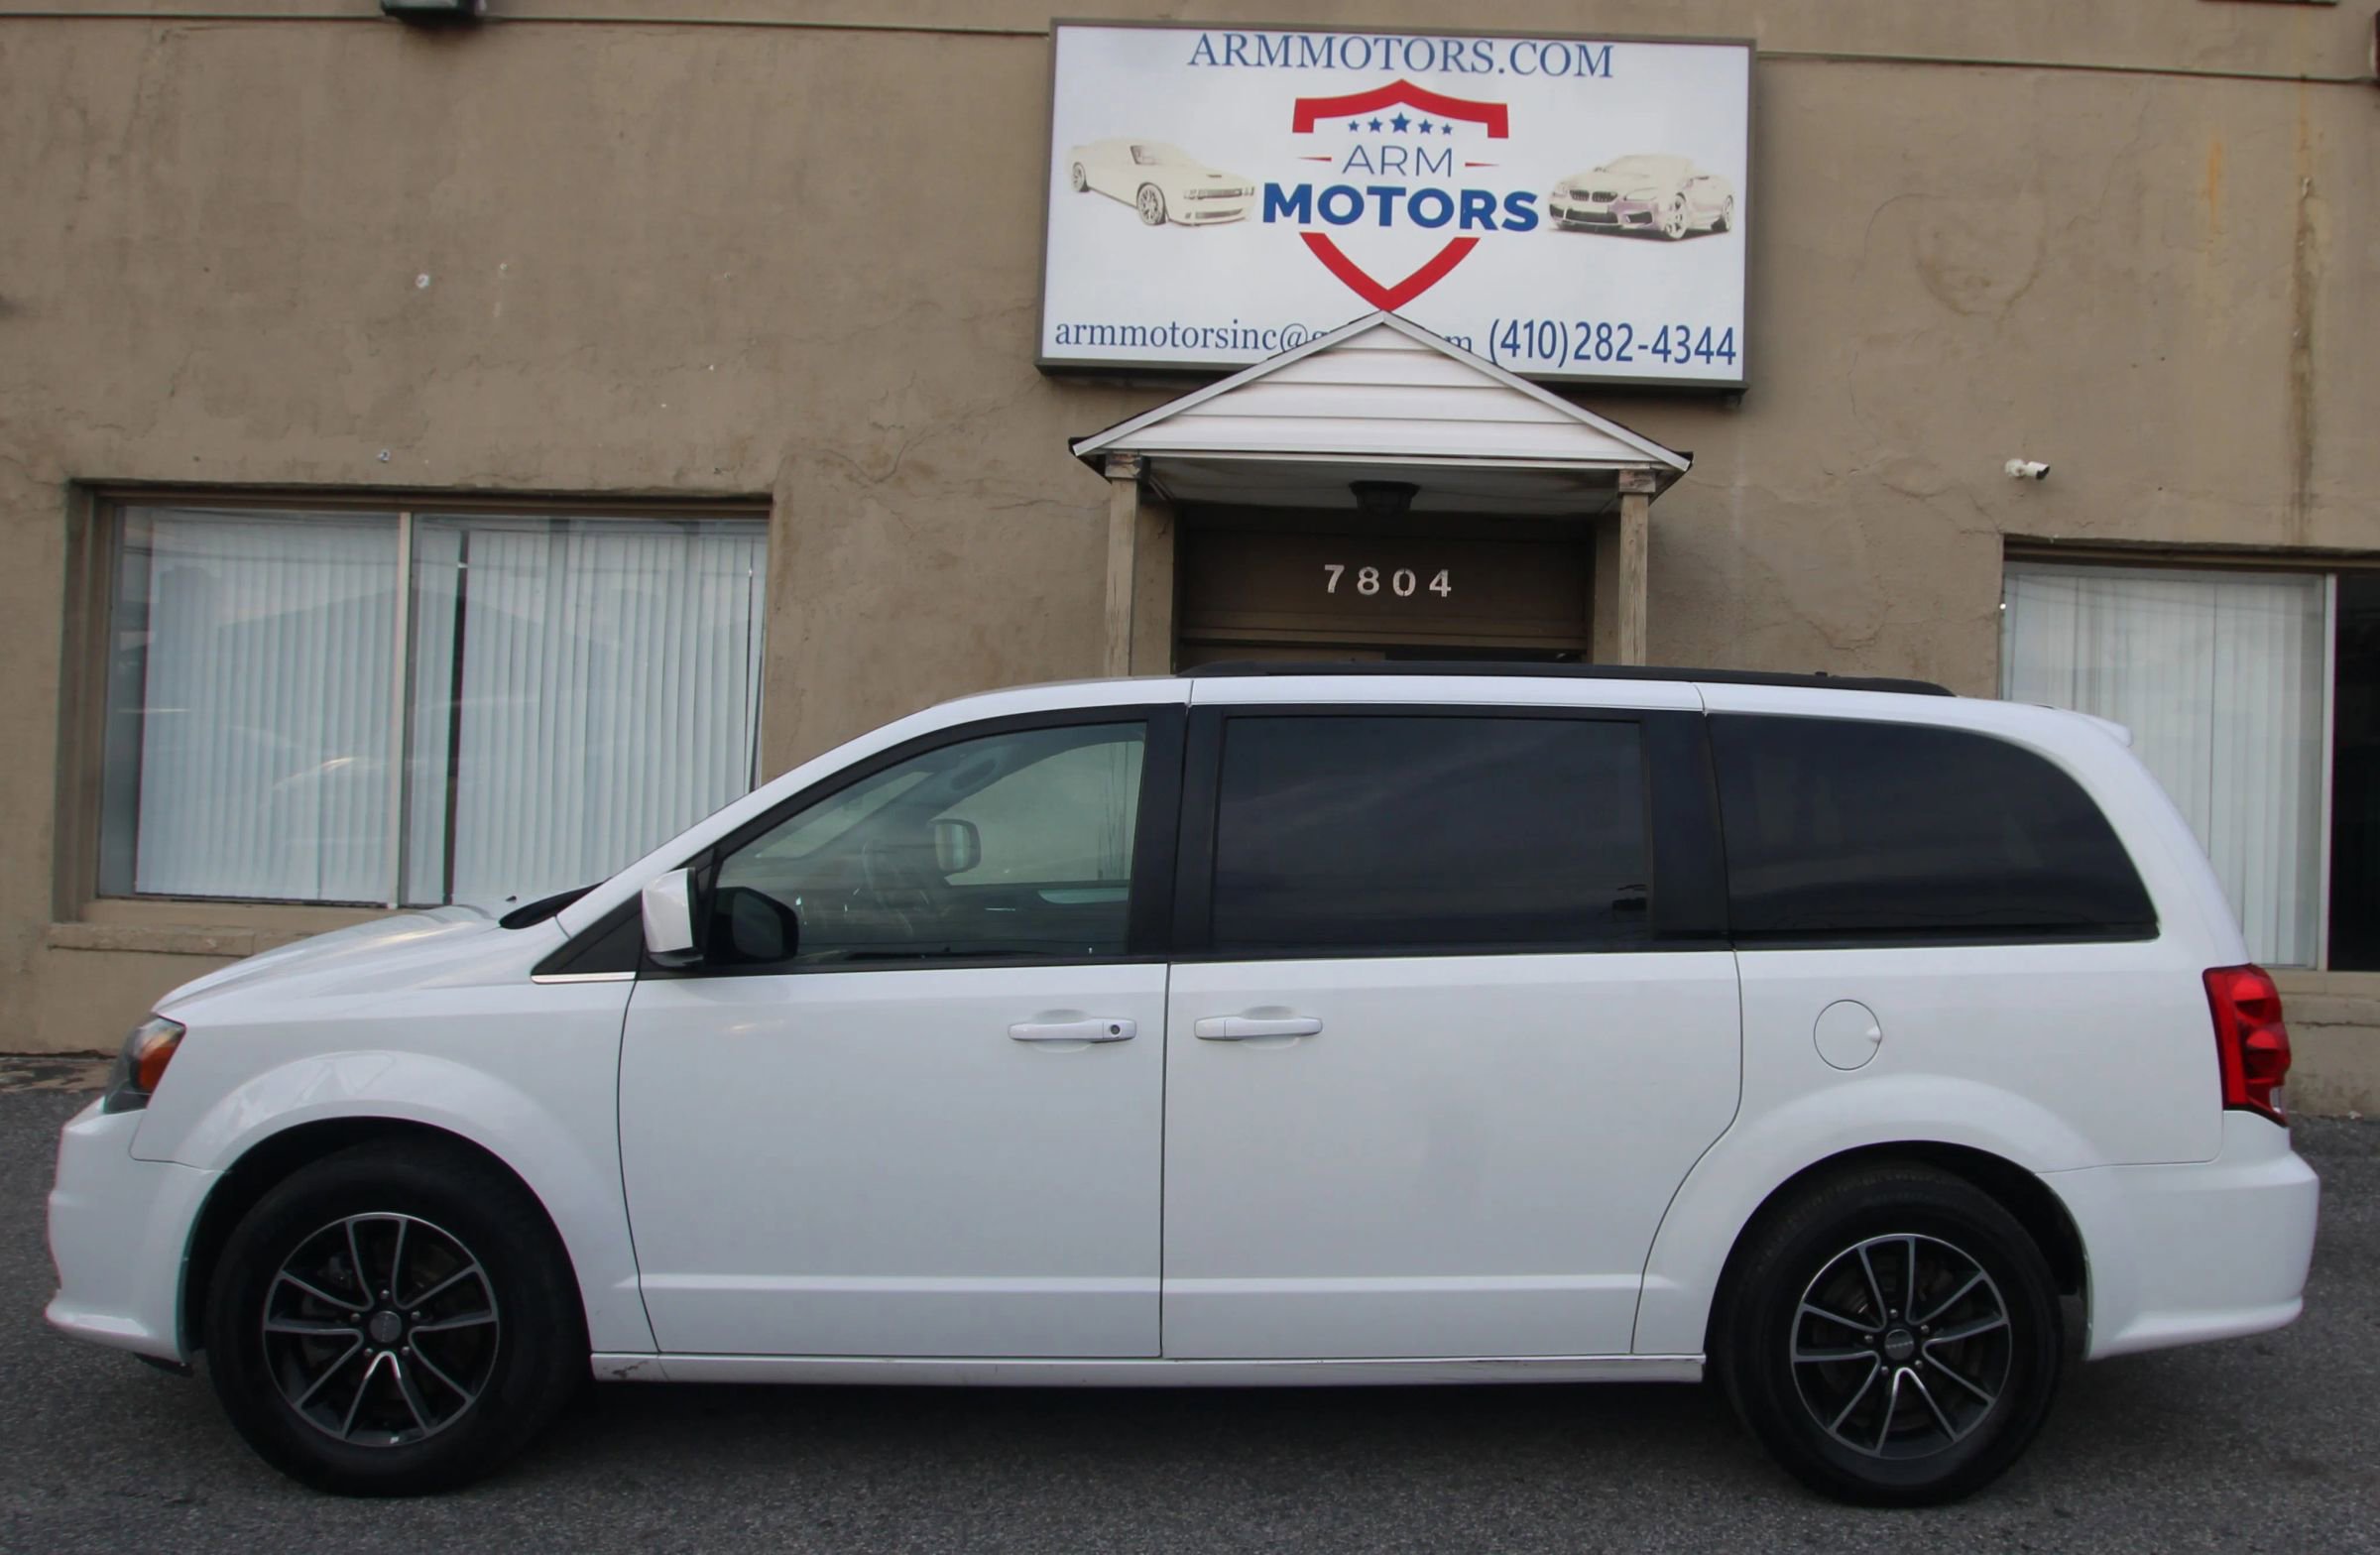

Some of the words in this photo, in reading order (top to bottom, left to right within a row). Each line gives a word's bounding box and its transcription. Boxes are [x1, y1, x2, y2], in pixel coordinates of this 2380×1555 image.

[1187, 32, 1614, 78] ARMMOTORS.COM
[1342, 144, 1453, 179] ARM
[1262, 181, 1539, 232] MOTORS
[1489, 318, 1736, 368] (410)282-4344
[1324, 563, 1452, 598] 7804
